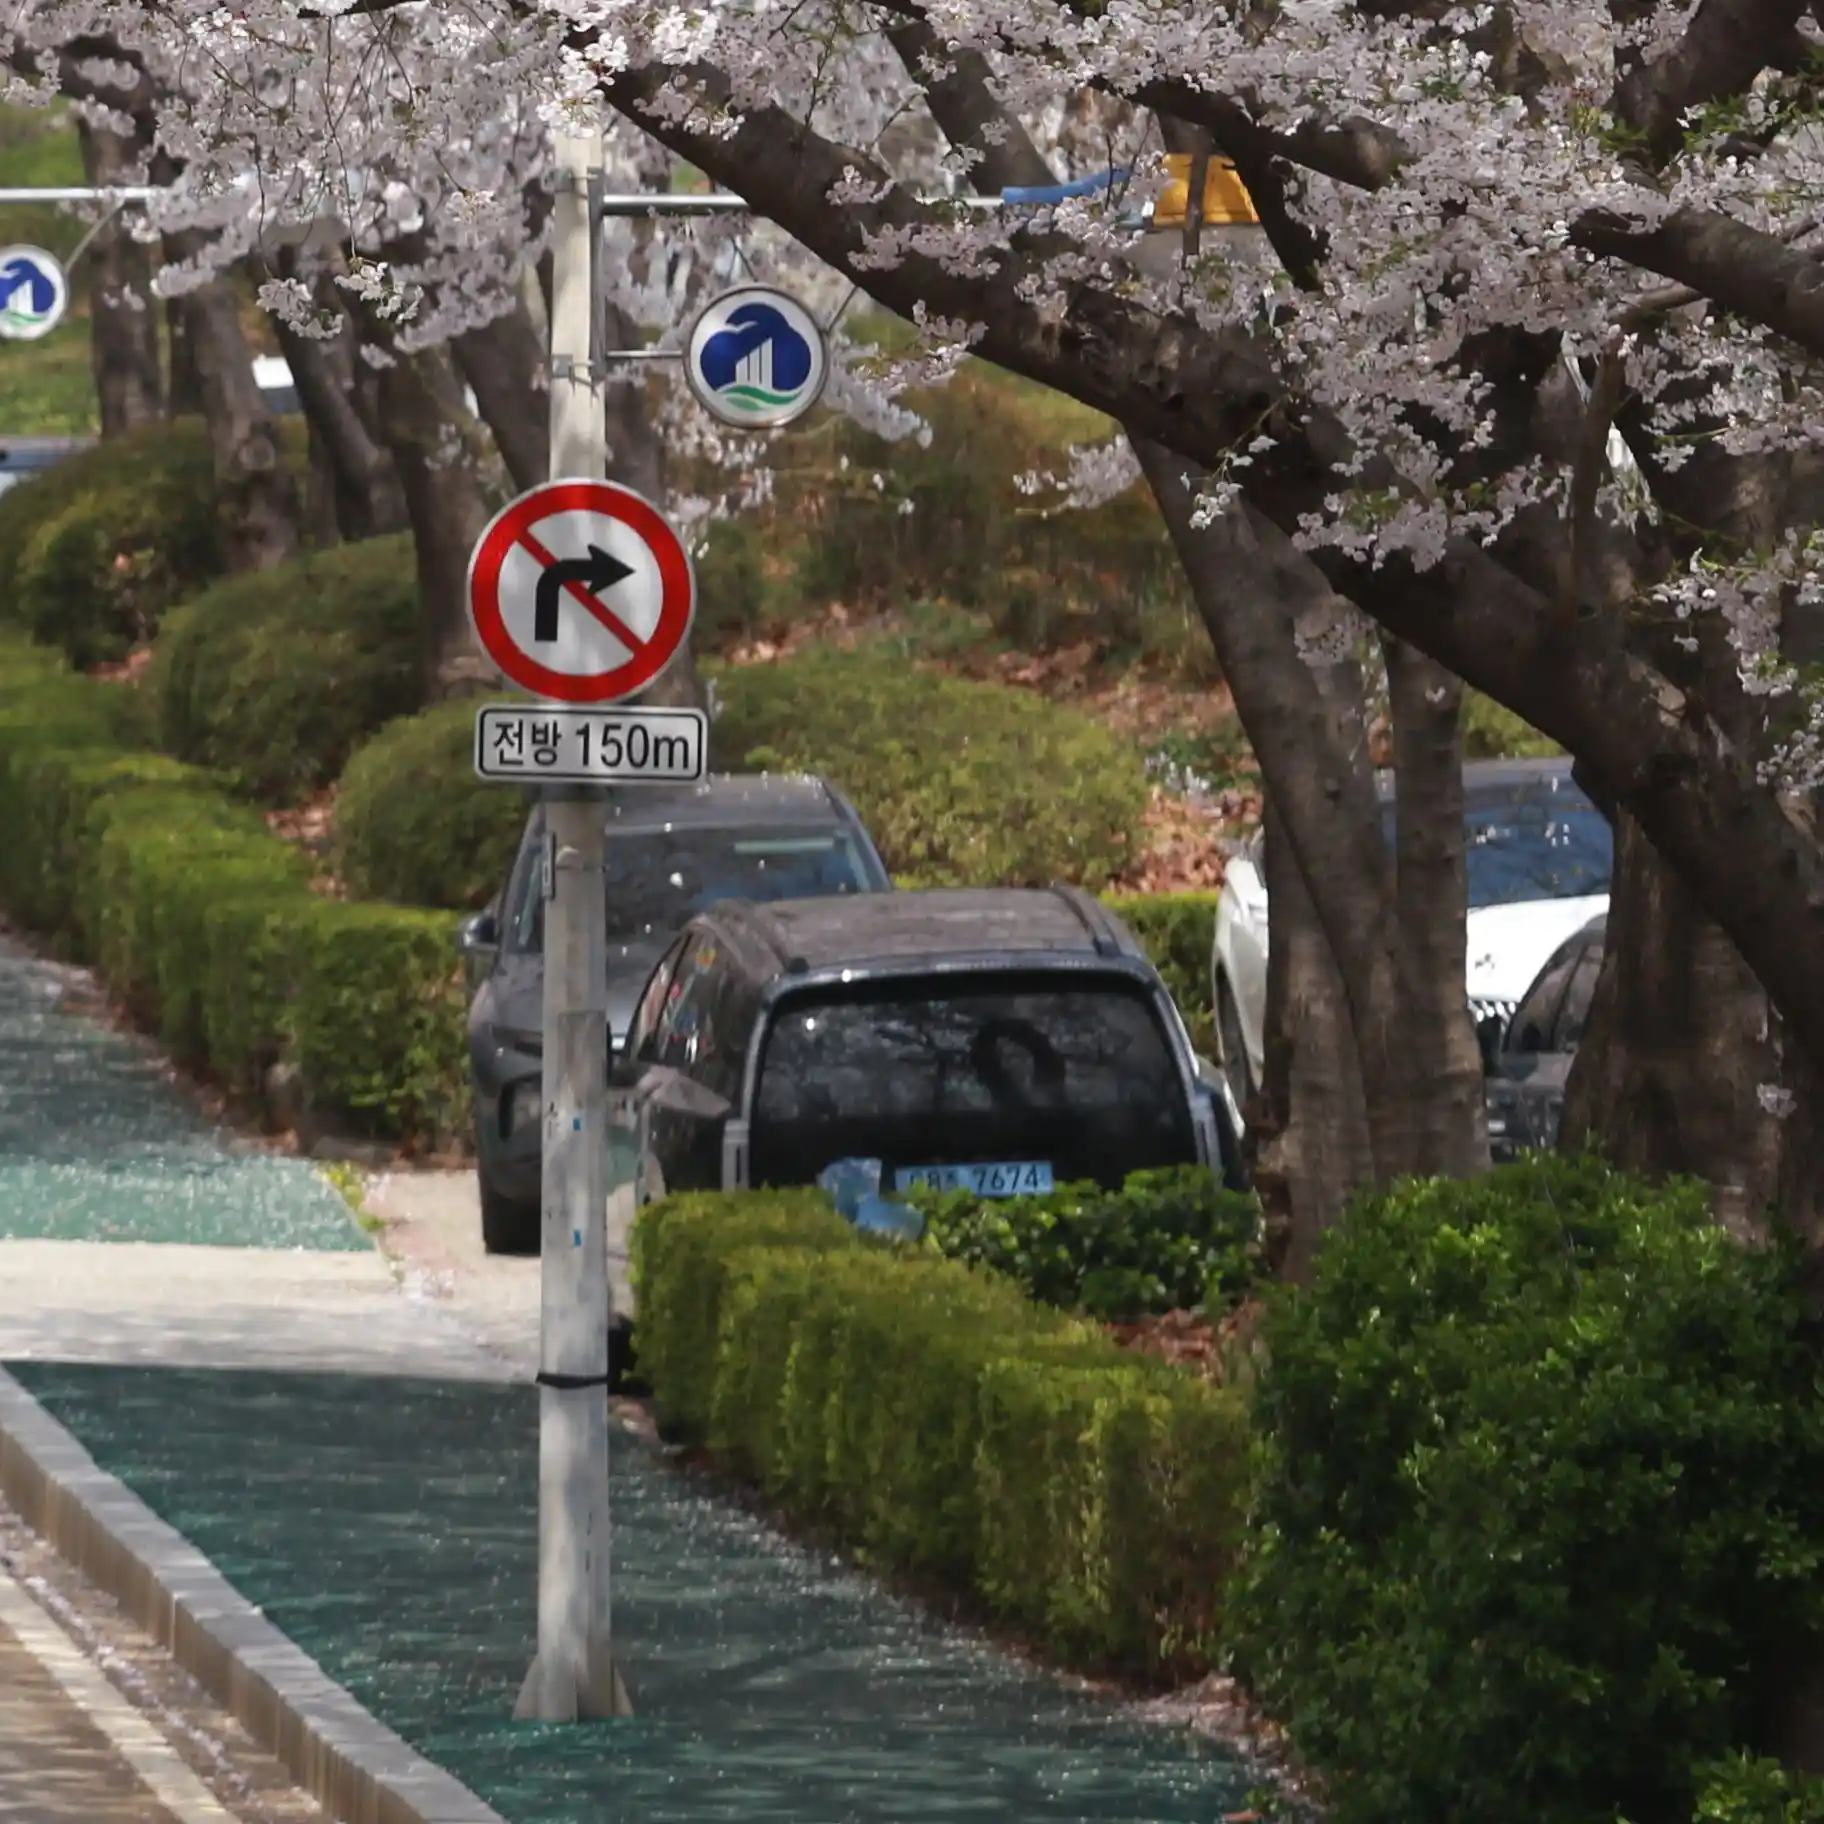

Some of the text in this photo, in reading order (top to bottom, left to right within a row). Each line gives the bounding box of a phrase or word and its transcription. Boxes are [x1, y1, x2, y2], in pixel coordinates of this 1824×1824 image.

[493, 719, 690, 769] 전방 150m
[971, 1163, 1039, 1193] 7674
